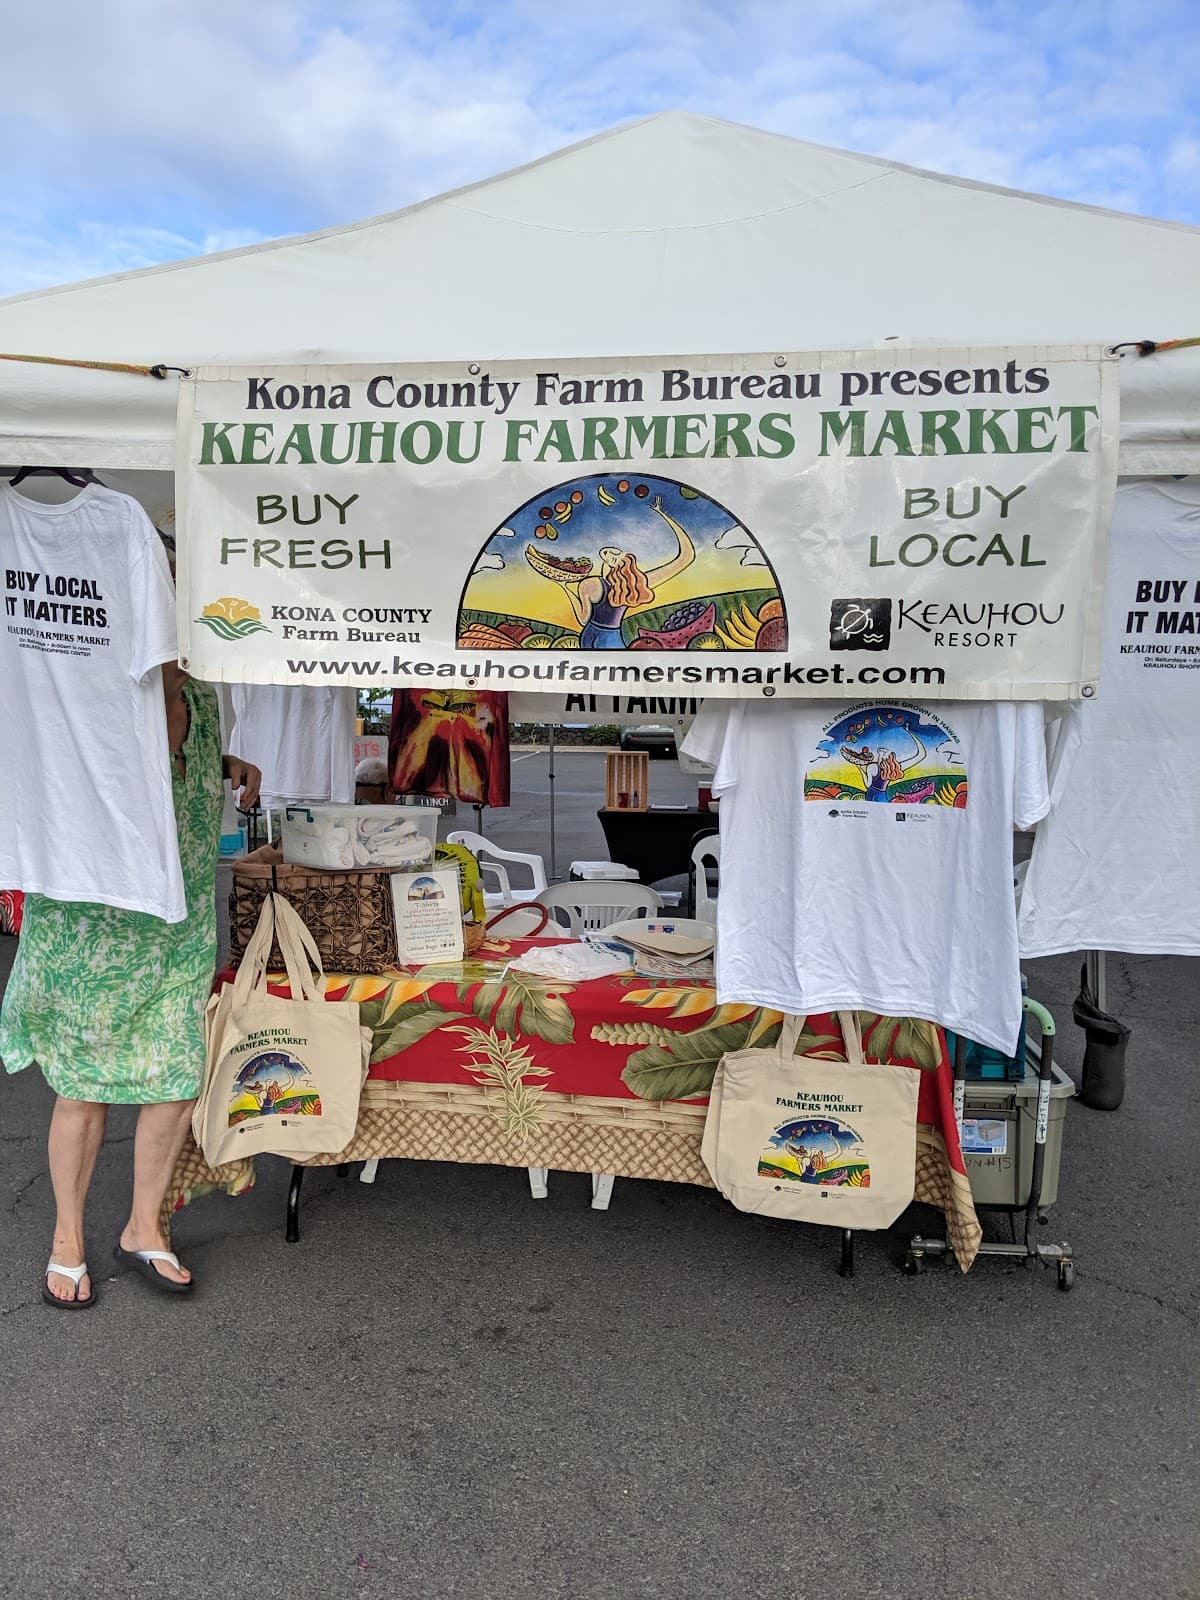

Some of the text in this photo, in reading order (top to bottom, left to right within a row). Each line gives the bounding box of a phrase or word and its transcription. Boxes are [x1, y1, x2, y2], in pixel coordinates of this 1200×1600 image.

[246, 360, 1051, 415] Kona County Farm Bureau presents
[199, 405, 1100, 466] KEAUHOU FARMERS MARKET
[256, 493, 360, 527] BUY
[904, 485, 1027, 520] BUY
[219, 537, 393, 570] FRESH
[868, 533, 1047, 569] LOCAL
[5, 569, 103, 601] BUY LOCAL
[1135, 580, 1188, 604] BUY
[5, 596, 110, 629] IT MATTERS.
[271, 605, 433, 624] KONA COUNTY
[898, 598, 1065, 633] KEAUHOU
[1126, 611, 1149, 634] IT
[76, 635, 111, 647] MARKET
[282, 625, 422, 644] Farm Bureau
[934, 632, 1018, 648] RESORT
[1120, 644, 1172, 654] KEAUHOU
[287, 655, 946, 687] www.keauhoufarmersmarket.com
[822, 720, 834, 733] ALL
[833, 702, 873, 722] PRODUCTS
[901, 701, 932, 717] GROWN
[931, 714, 941, 722] IN
[420, 797, 449, 808] LUNCH
[230, 1039, 270, 1055] FARMERS
[273, 1037, 309, 1046] MARKET
[247, 1028, 292, 1041] KEAUHOU
[775, 1097, 864, 1113] FARMERS MARKET
[796, 1091, 845, 1103] KEAUHOU
